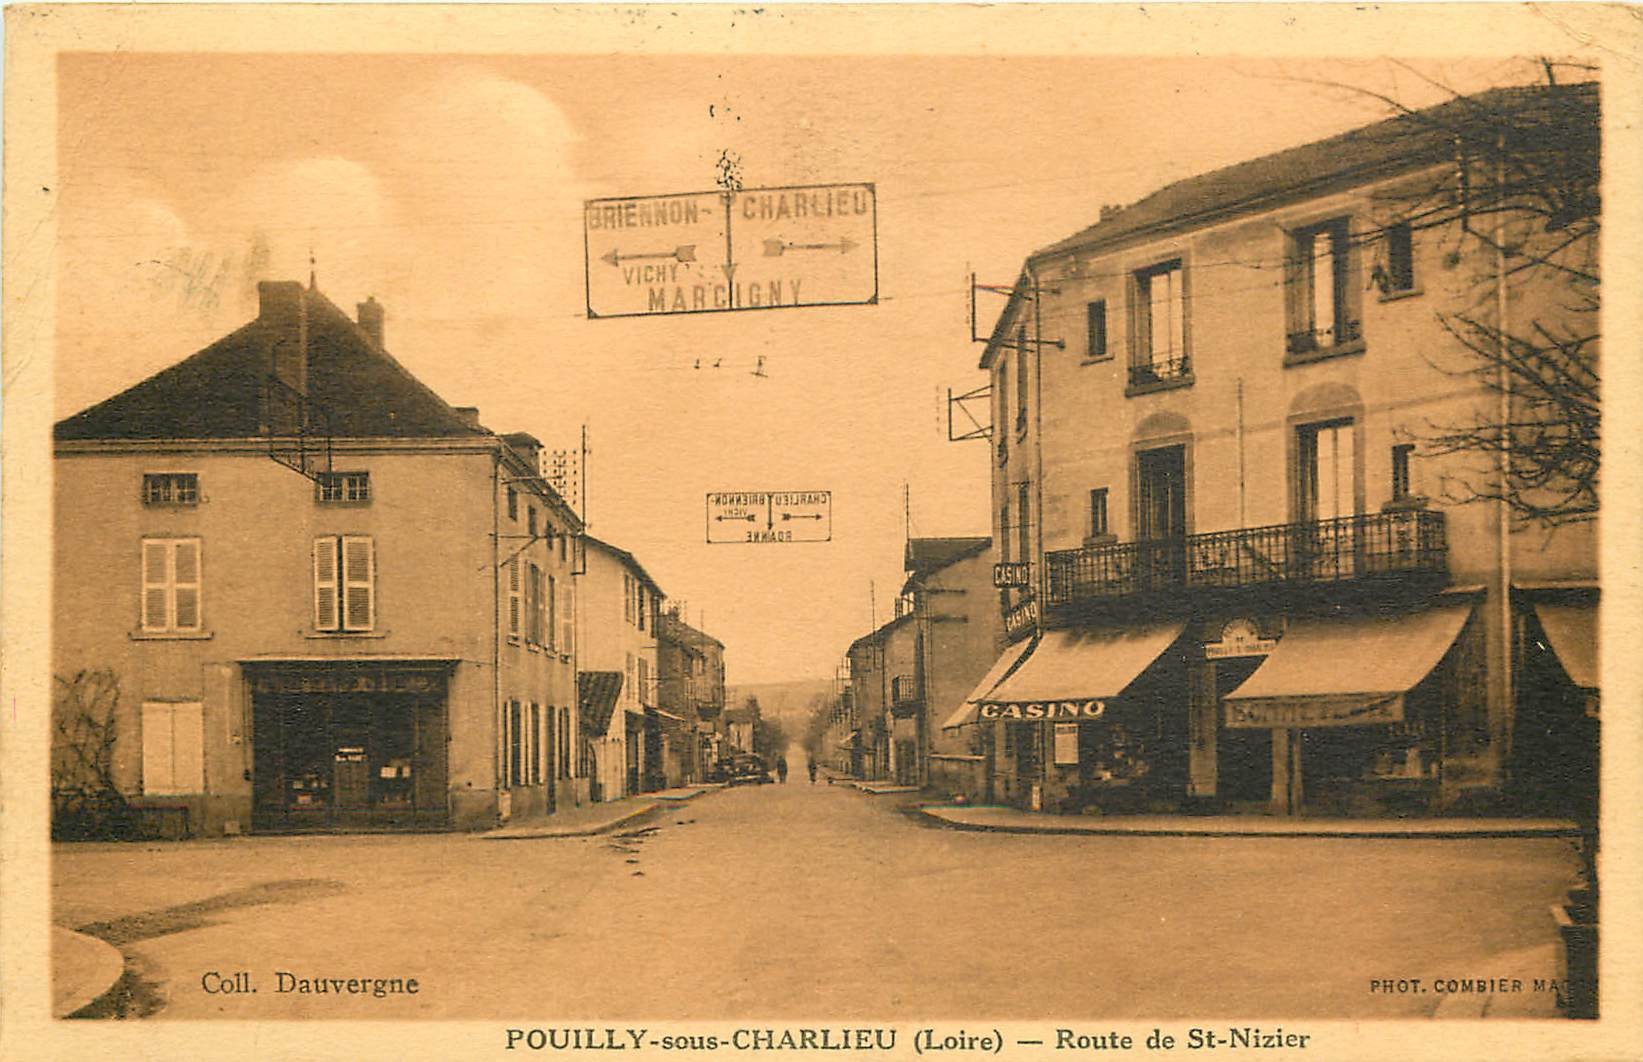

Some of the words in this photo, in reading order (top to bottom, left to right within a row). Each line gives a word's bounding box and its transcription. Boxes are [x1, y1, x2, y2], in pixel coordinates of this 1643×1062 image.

[742, 190, 869, 221] CHARLIEU
[622, 264, 679, 286] VICHY
[647, 278, 803, 312] MARCIGNY
[994, 566, 1029, 585] CASINO
[1006, 600, 1038, 632] CASINO
[981, 700, 1106, 719] CASINO
